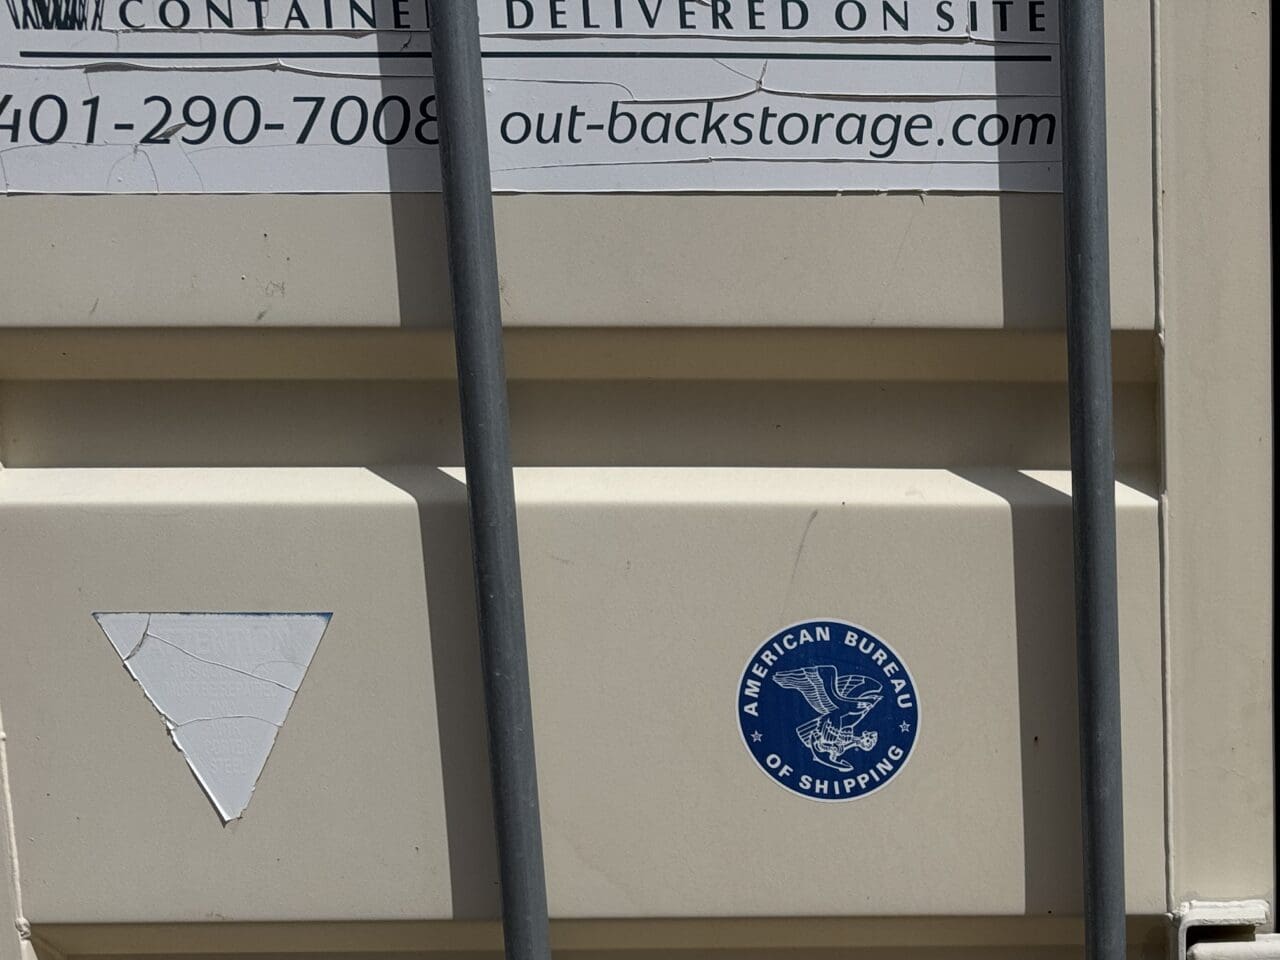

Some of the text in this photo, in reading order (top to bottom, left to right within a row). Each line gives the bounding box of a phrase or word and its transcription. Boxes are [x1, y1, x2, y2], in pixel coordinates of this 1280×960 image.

[119, 0, 1046, 32] CONTAINE DELIVERED ON SITE
[0, 93, 1057, 158] 401-290-7008 out-backstorage.com
[743, 626, 913, 716] AMERICAN BUREAU
[766, 744, 904, 795] OF SHIPPING
